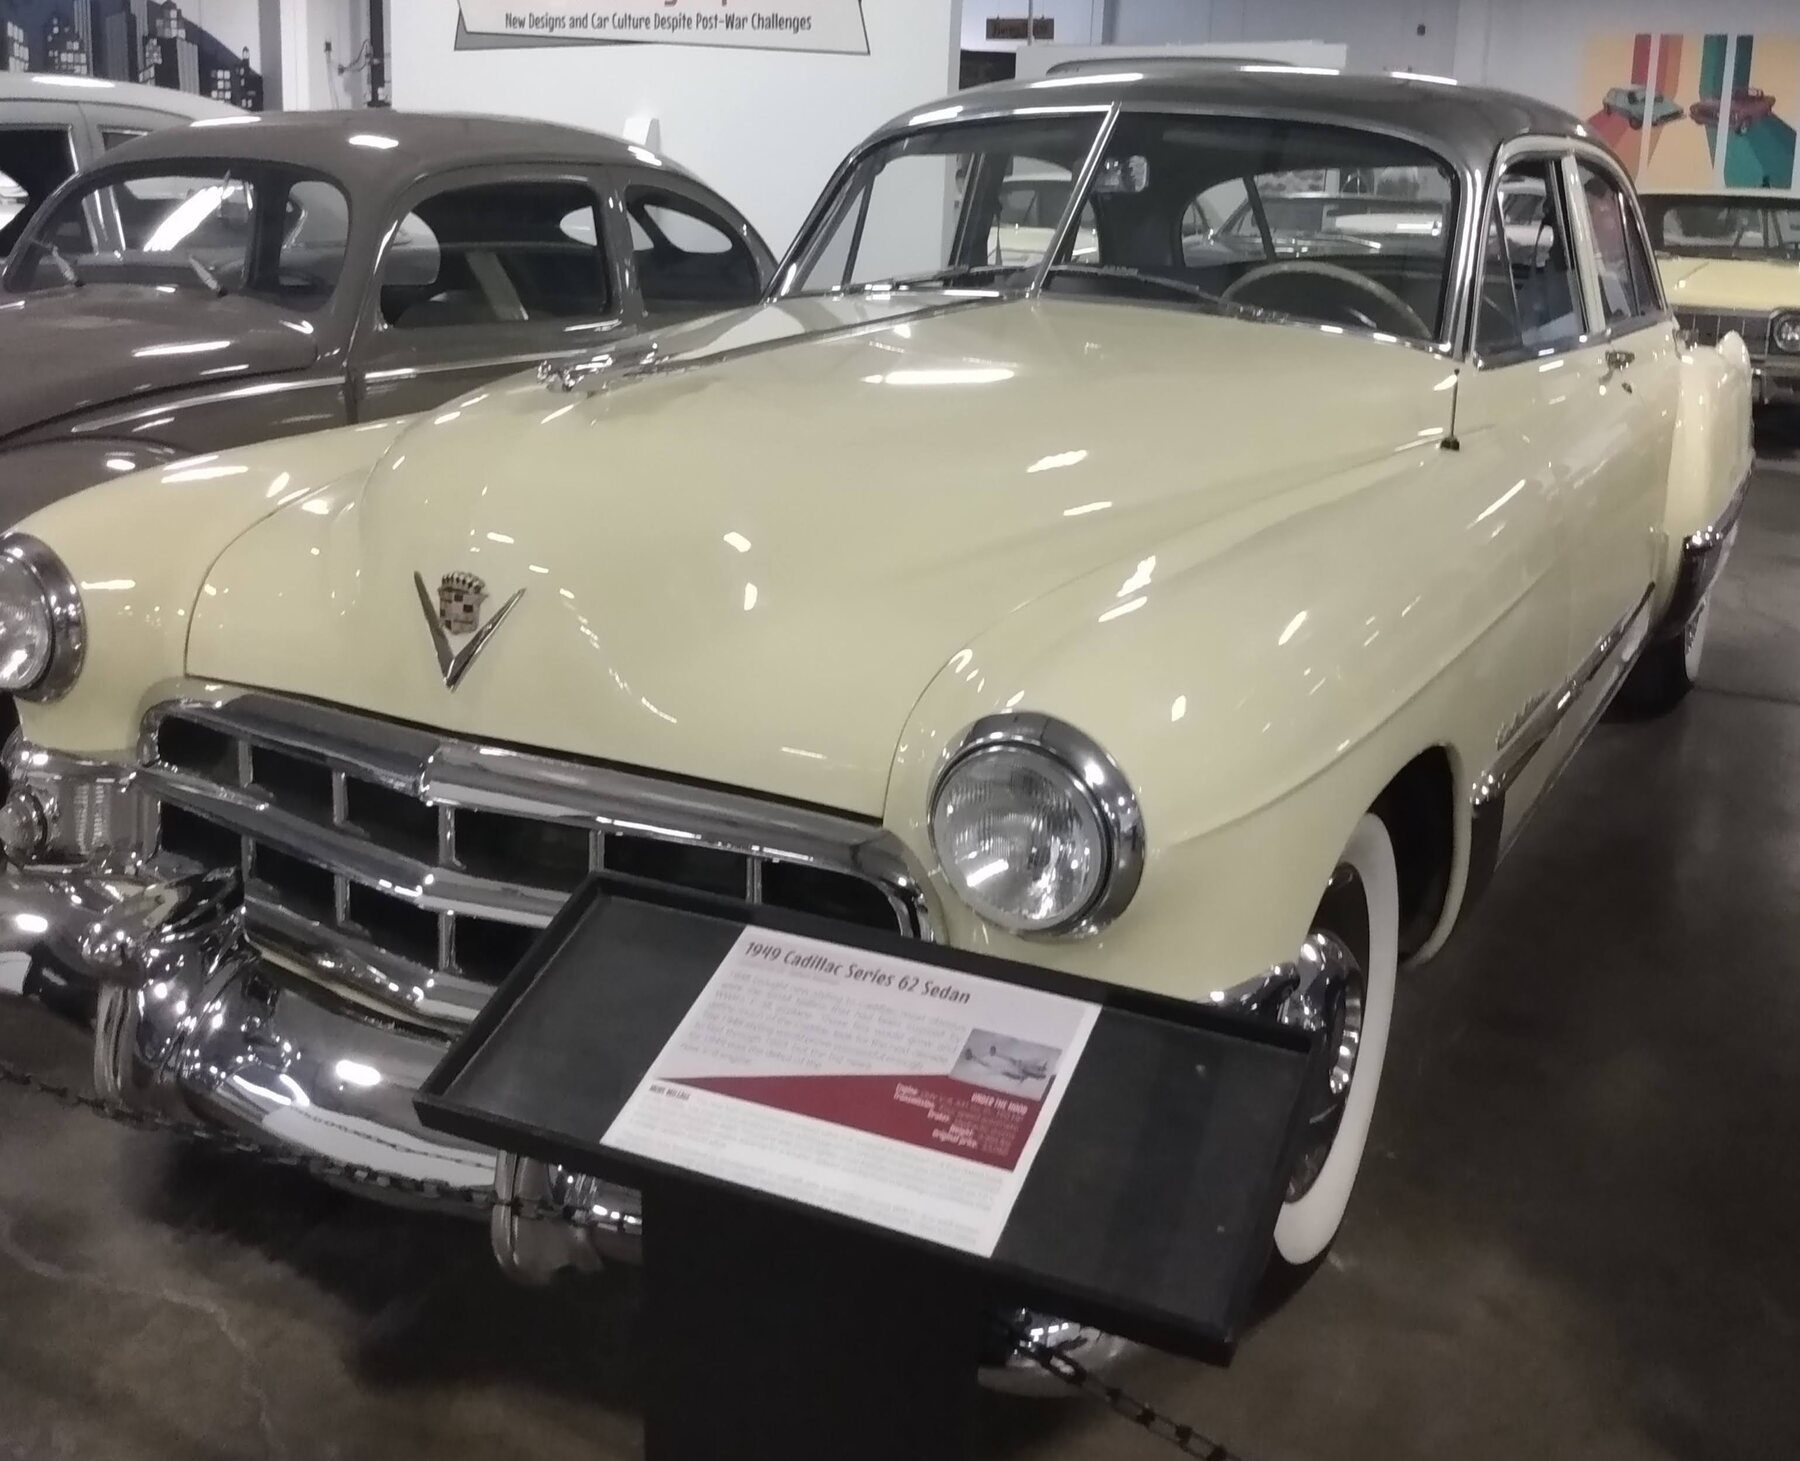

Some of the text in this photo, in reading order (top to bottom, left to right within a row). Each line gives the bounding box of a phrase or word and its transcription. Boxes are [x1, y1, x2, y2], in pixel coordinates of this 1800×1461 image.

[504, 12, 812, 34] New Designs and Car Culture Despite Post-War Challenges
[746, 941, 782, 960] 1949
[783, 950, 844, 976] Cadillac
[846, 963, 895, 987] Series
[898, 975, 920, 992] 62
[922, 980, 971, 1004] Sedan
